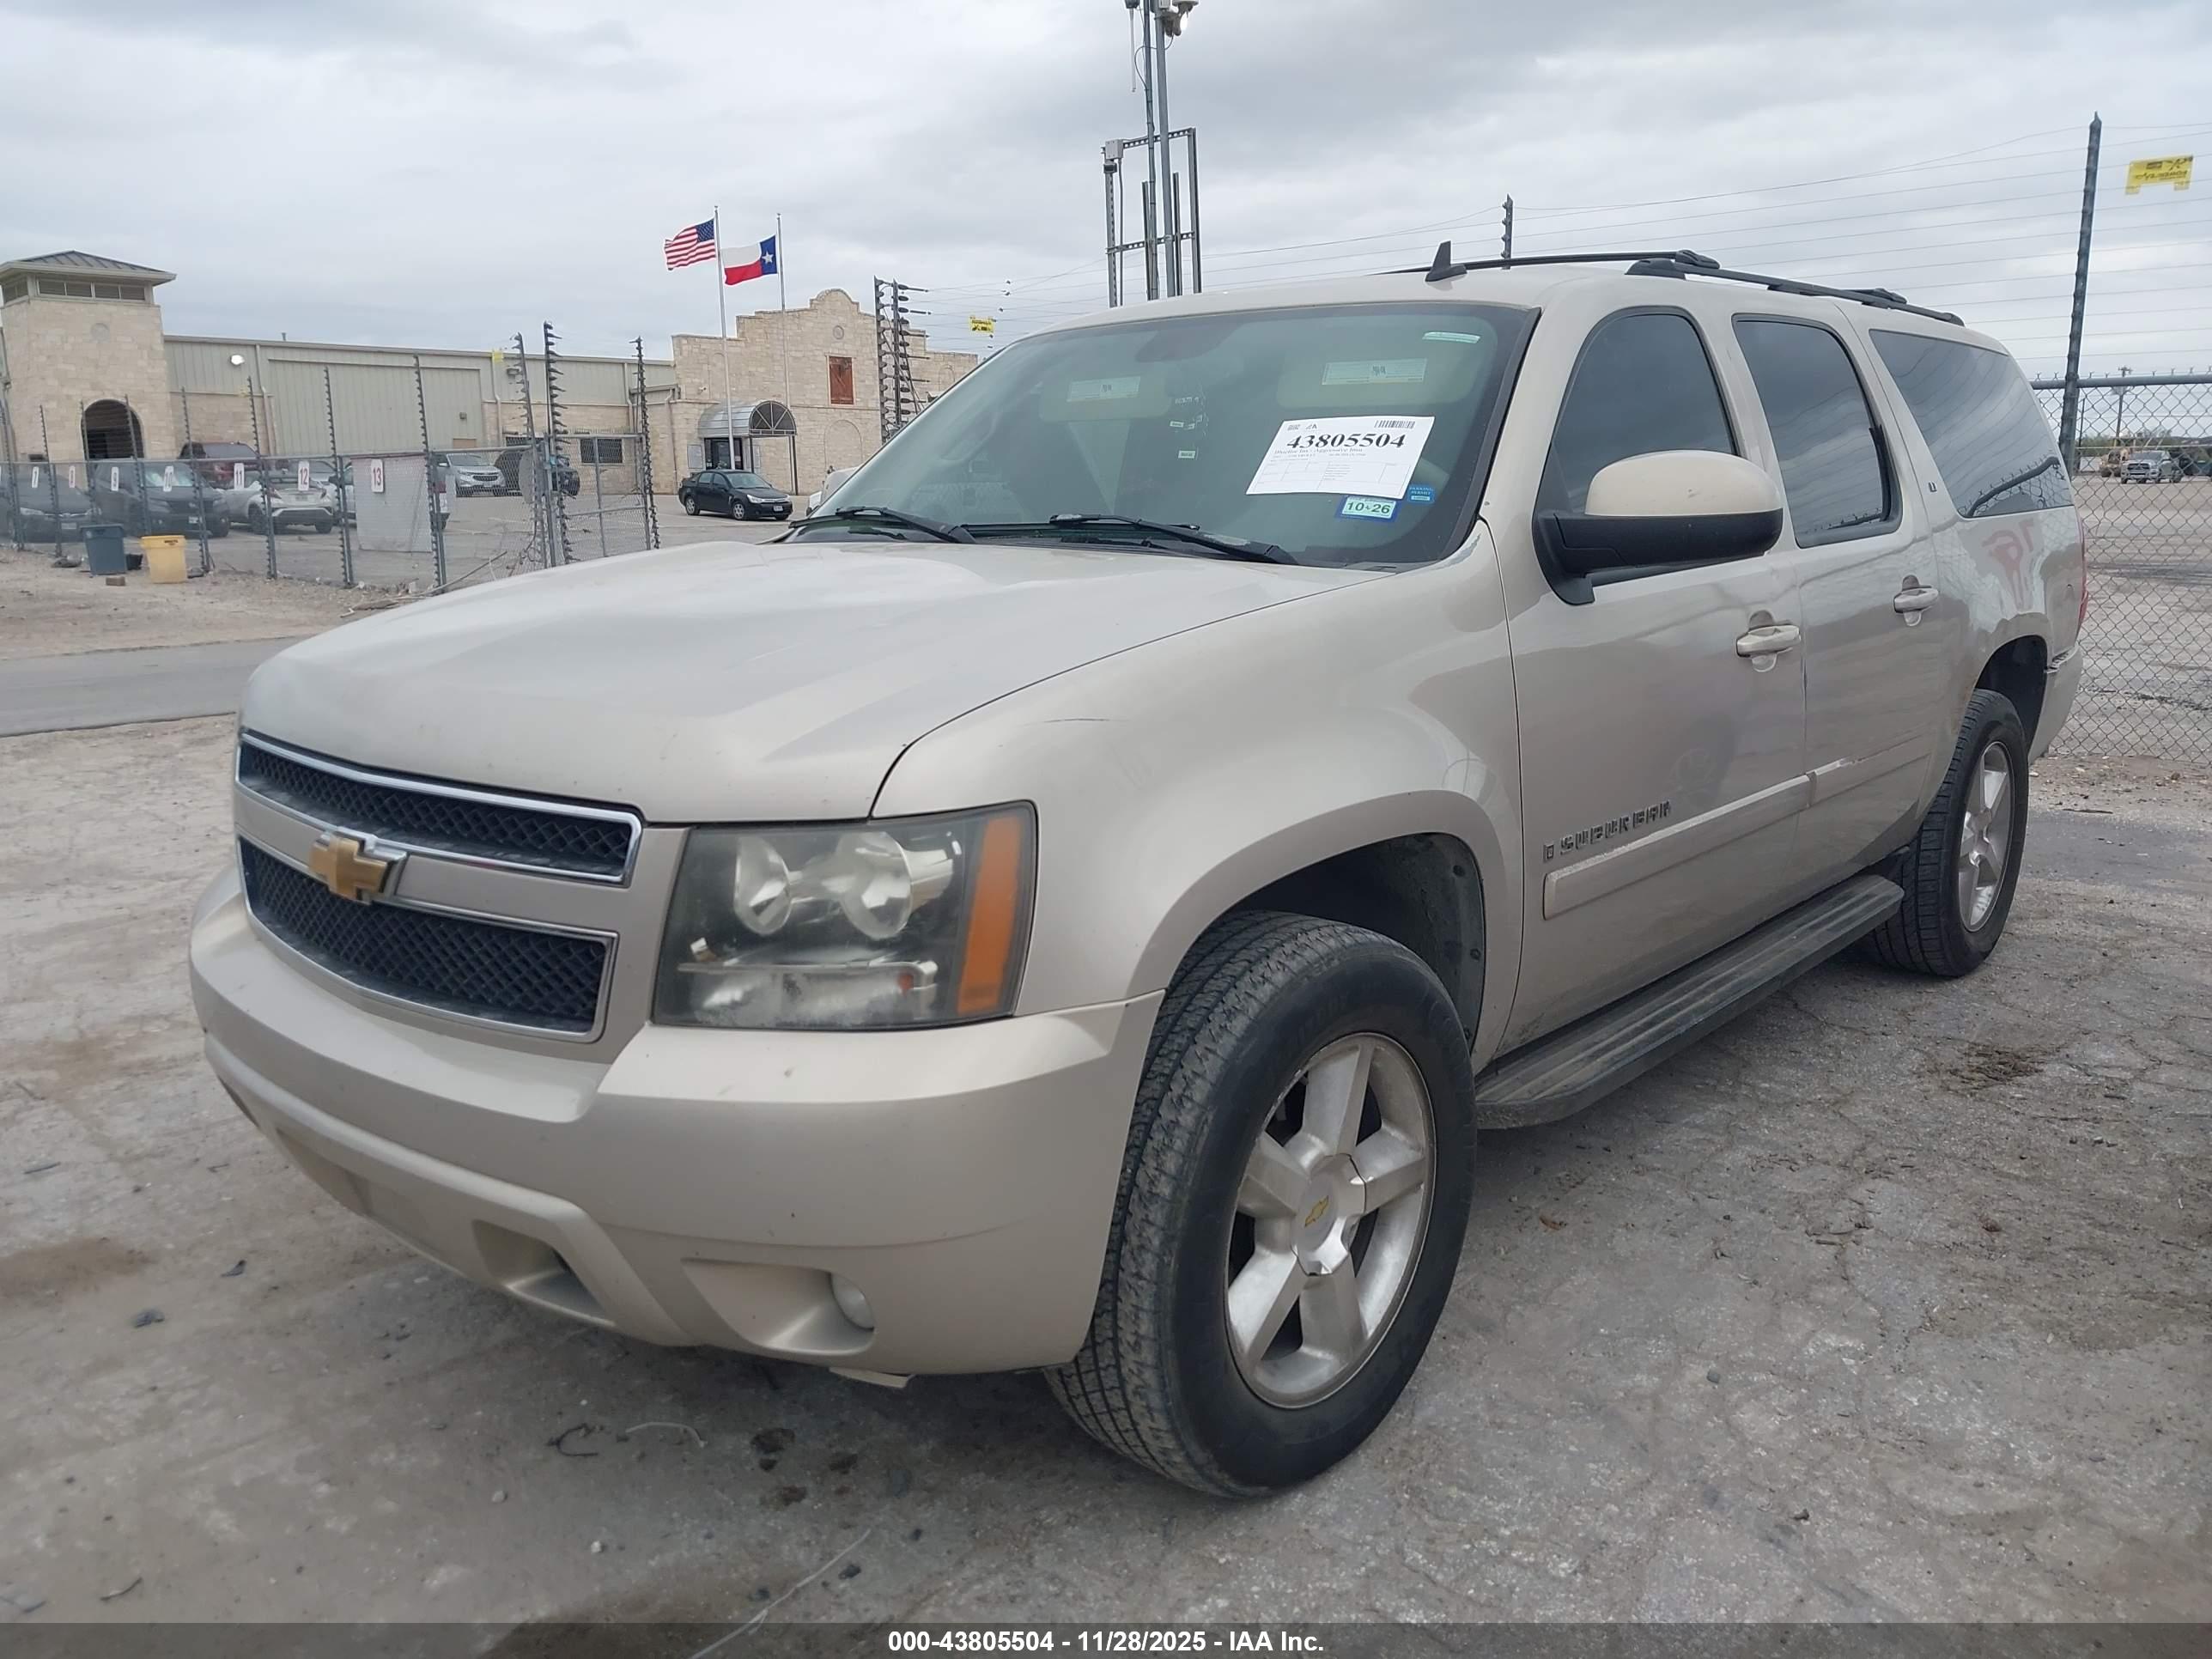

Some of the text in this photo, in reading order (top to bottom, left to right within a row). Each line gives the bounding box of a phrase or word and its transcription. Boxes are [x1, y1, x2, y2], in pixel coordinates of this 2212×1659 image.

[1286, 433, 1406, 448] 43805504
[299, 467, 309, 486] 12
[372, 466, 383, 487] 13
